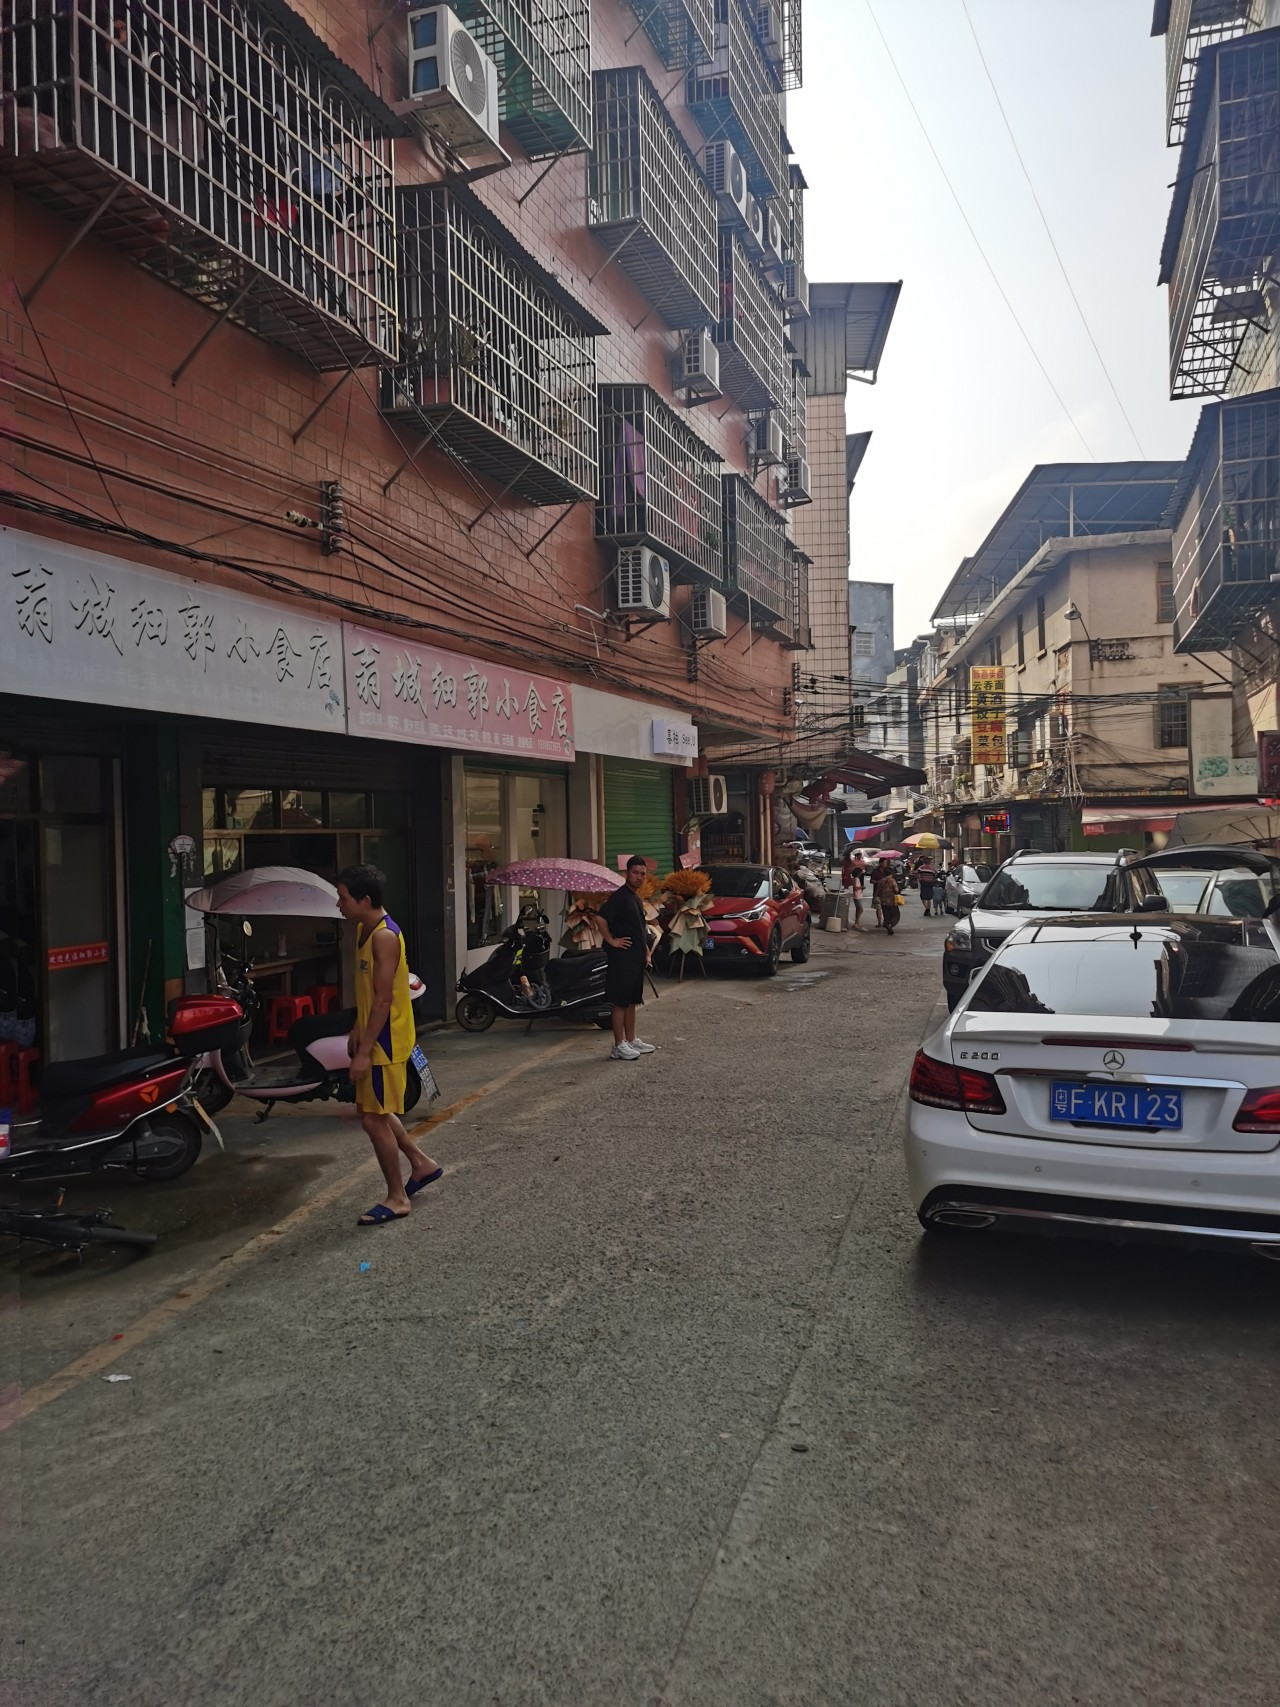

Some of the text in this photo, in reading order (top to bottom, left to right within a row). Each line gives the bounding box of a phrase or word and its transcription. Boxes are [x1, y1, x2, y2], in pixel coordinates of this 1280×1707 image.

[11, 562, 331, 690] 翁城细郭小食店
[352, 638, 568, 739] 翁城细郭小食店
[973, 681, 1004, 690] 云吞面
[977, 735, 1003, 747] 菜包
